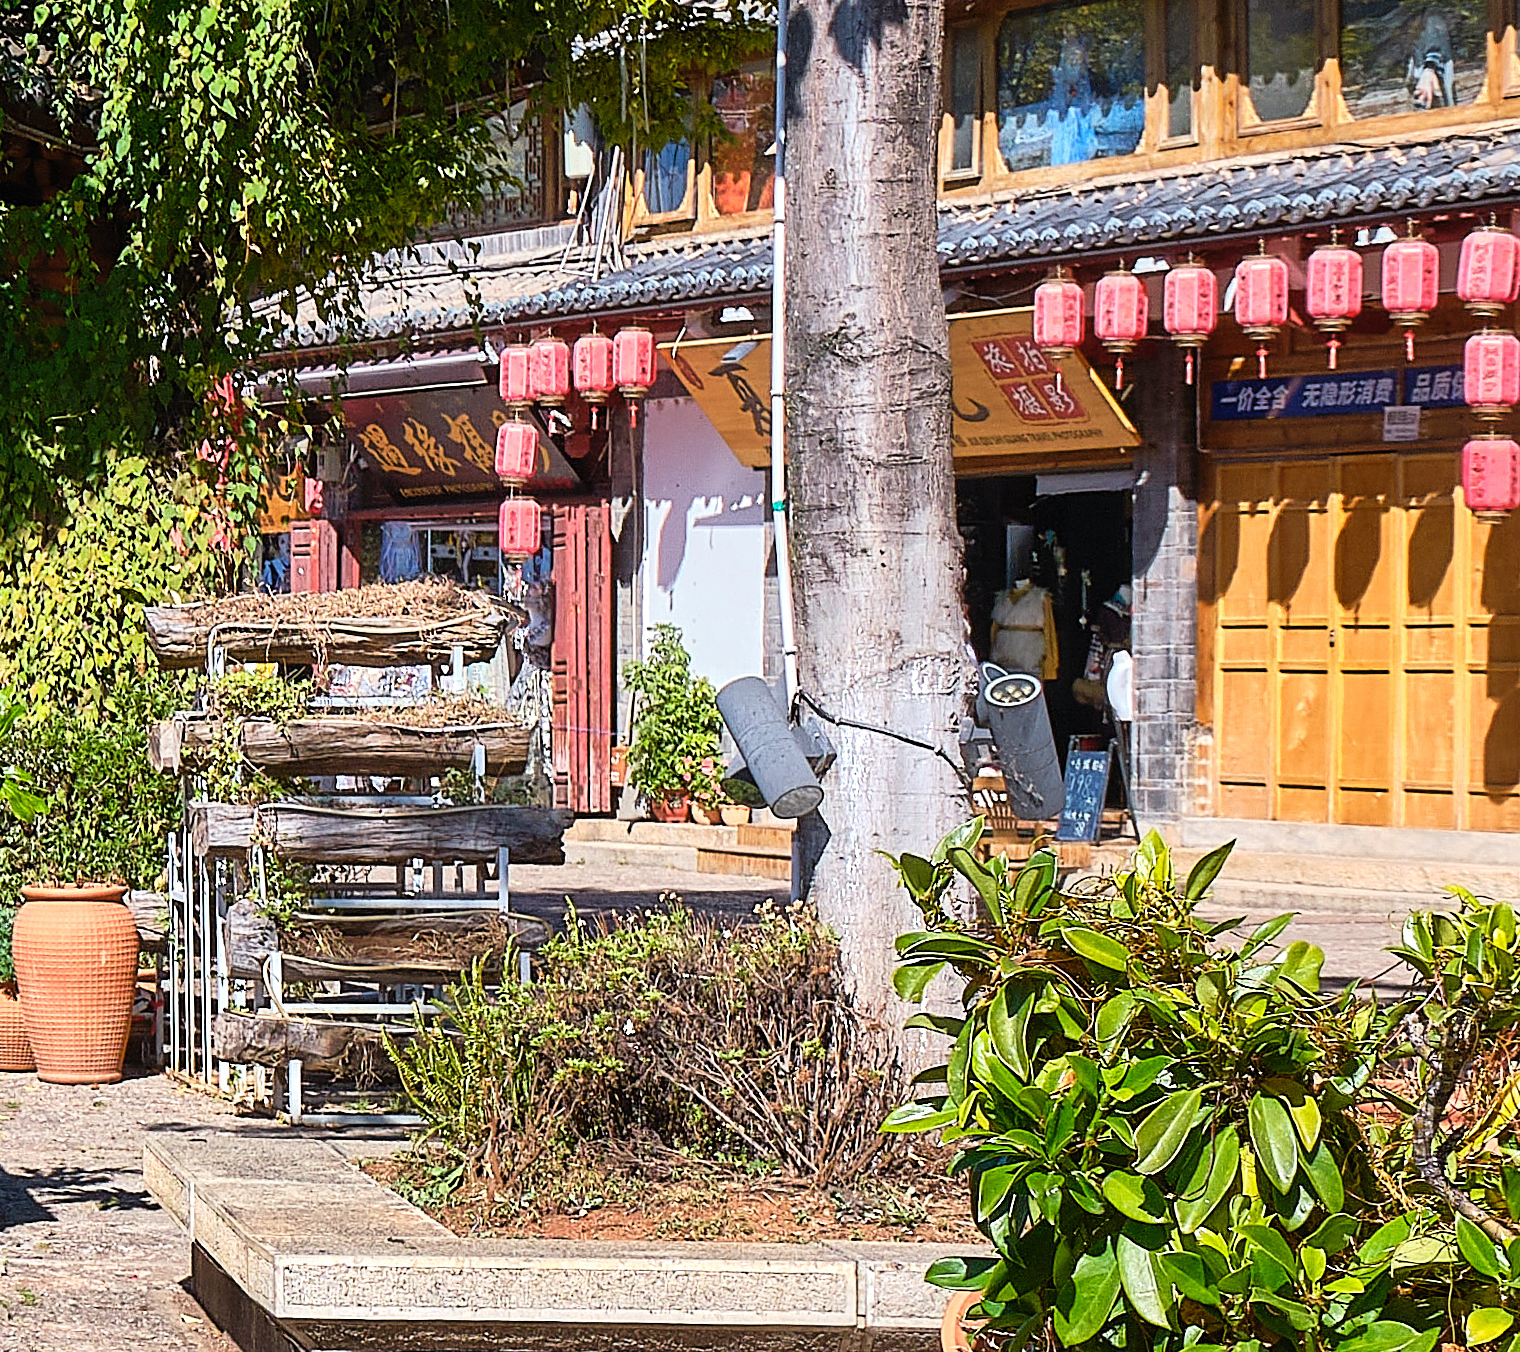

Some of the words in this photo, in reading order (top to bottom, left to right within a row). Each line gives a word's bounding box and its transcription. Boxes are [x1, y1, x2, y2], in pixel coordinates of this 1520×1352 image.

[1220, 386, 1289, 413] 一价全含
[1301, 378, 1395, 408] 无隐形消费
